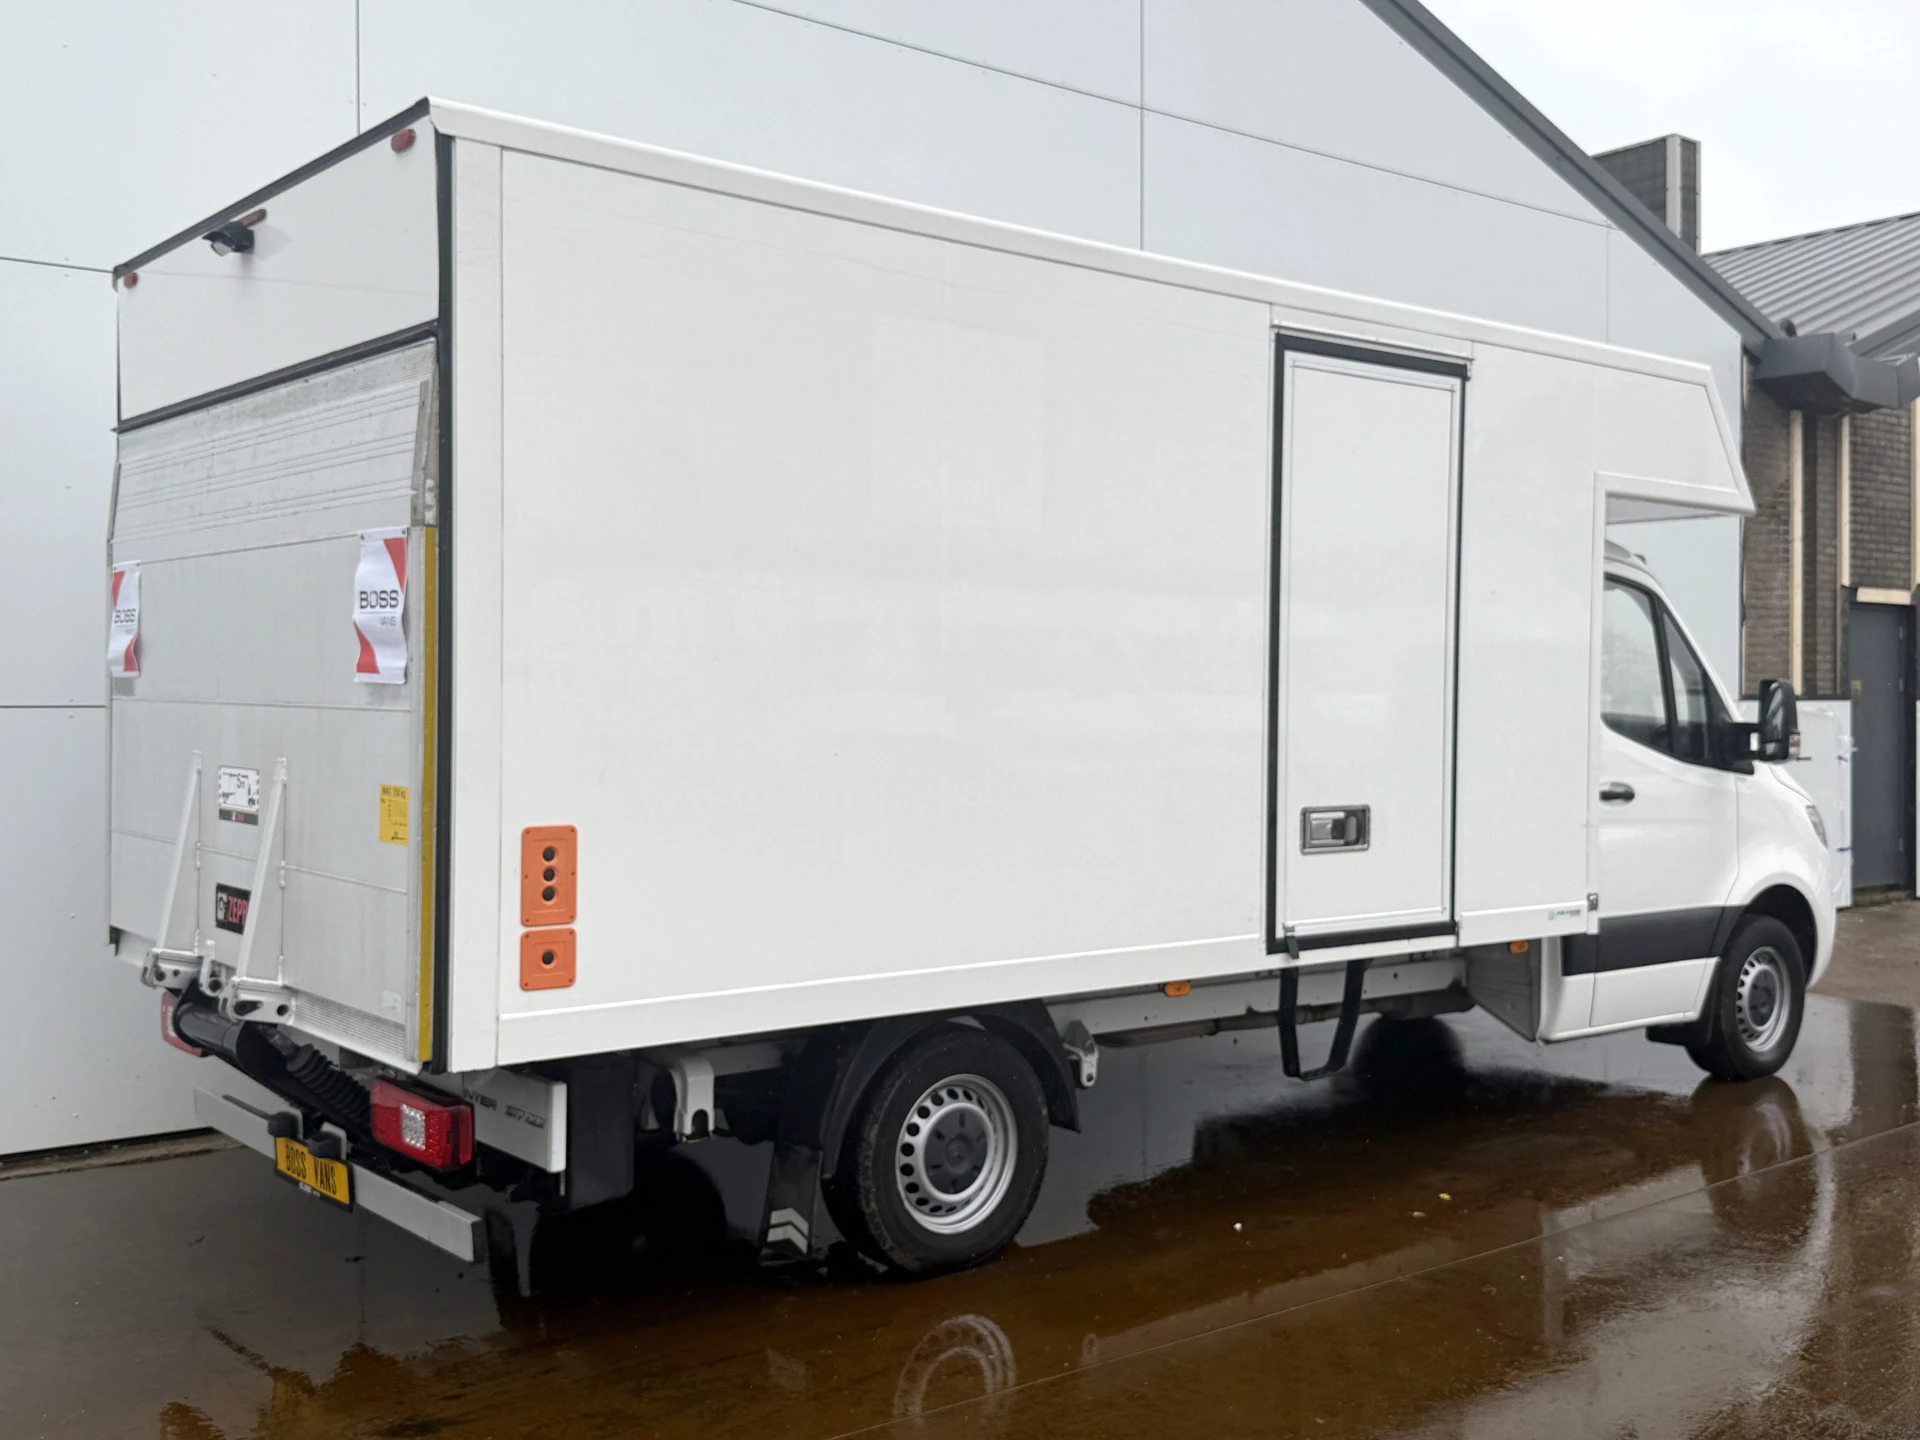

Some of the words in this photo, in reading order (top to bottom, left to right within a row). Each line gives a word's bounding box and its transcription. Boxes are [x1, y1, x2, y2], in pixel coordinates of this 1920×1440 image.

[359, 590, 399, 609] BOSS
[114, 608, 136, 623] BOSS
[228, 895, 249, 926] ZEPR
[286, 1143, 306, 1180] BOSS
[314, 1157, 337, 1195] VANS
